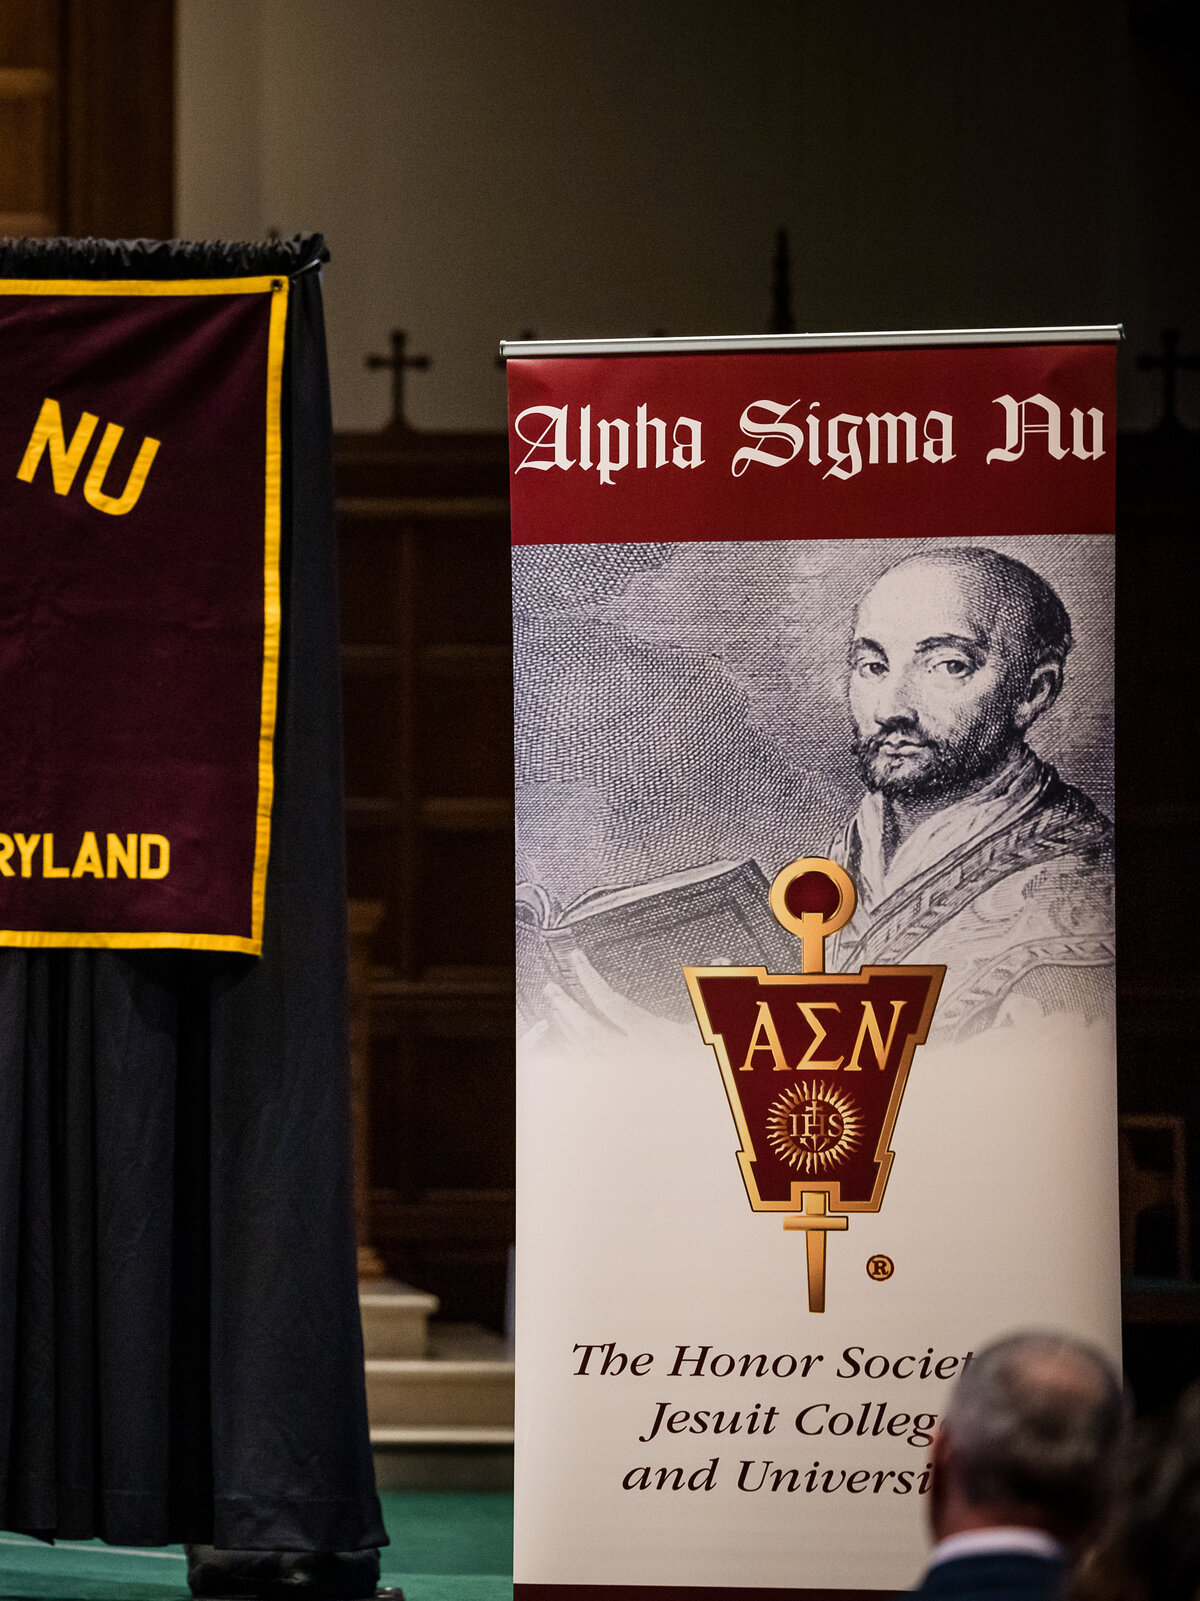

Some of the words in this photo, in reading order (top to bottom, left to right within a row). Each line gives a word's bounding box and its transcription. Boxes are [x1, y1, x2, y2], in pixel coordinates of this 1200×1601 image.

[17, 398, 161, 516] NU
[514, 402, 706, 485] Alpha
[731, 398, 957, 481] Sigma
[986, 393, 1106, 465] Nu
[789, 1113, 843, 1138] IHS
[573, 1342, 654, 1377] The
[667, 1344, 824, 1378] Honor
[836, 1346, 974, 1380] Societ
[639, 1402, 779, 1442] Jesuit
[794, 1402, 938, 1448] Colleg
[622, 1457, 720, 1491] and
[736, 1460, 934, 1495] Universi
